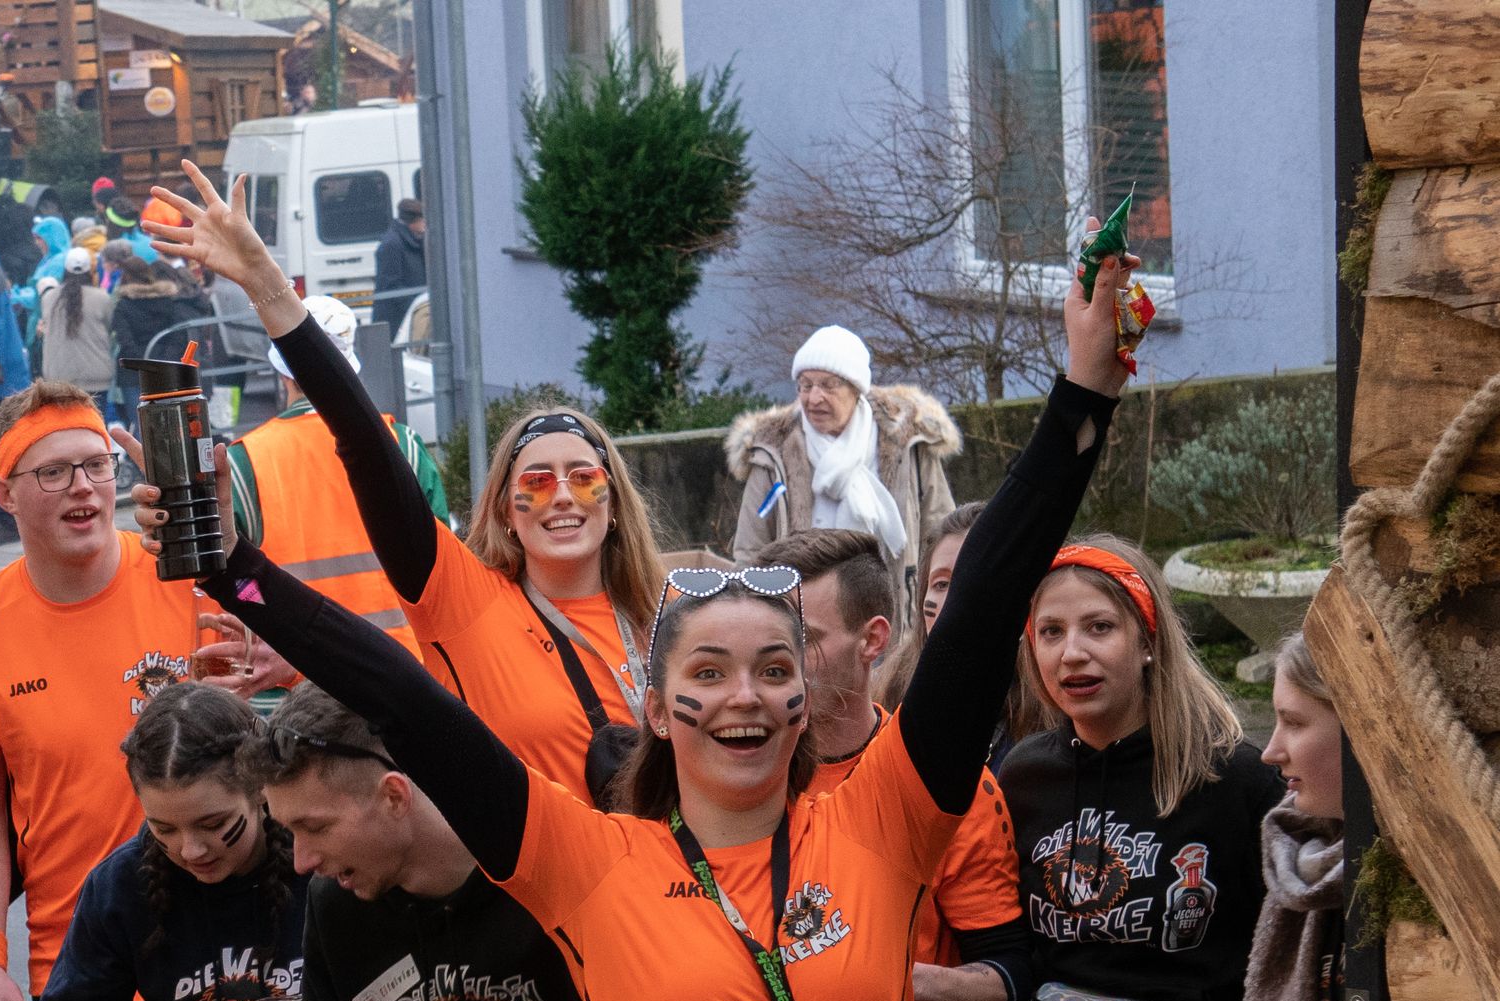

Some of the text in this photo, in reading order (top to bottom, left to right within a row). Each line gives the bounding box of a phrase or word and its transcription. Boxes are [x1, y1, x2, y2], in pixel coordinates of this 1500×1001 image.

[9, 678, 48, 697] JAKO
[779, 908, 851, 966] KERLE
[1029, 893, 1153, 943] KERLE
[1179, 919, 1198, 929] FETT
[221, 946, 304, 996] WiLDE
